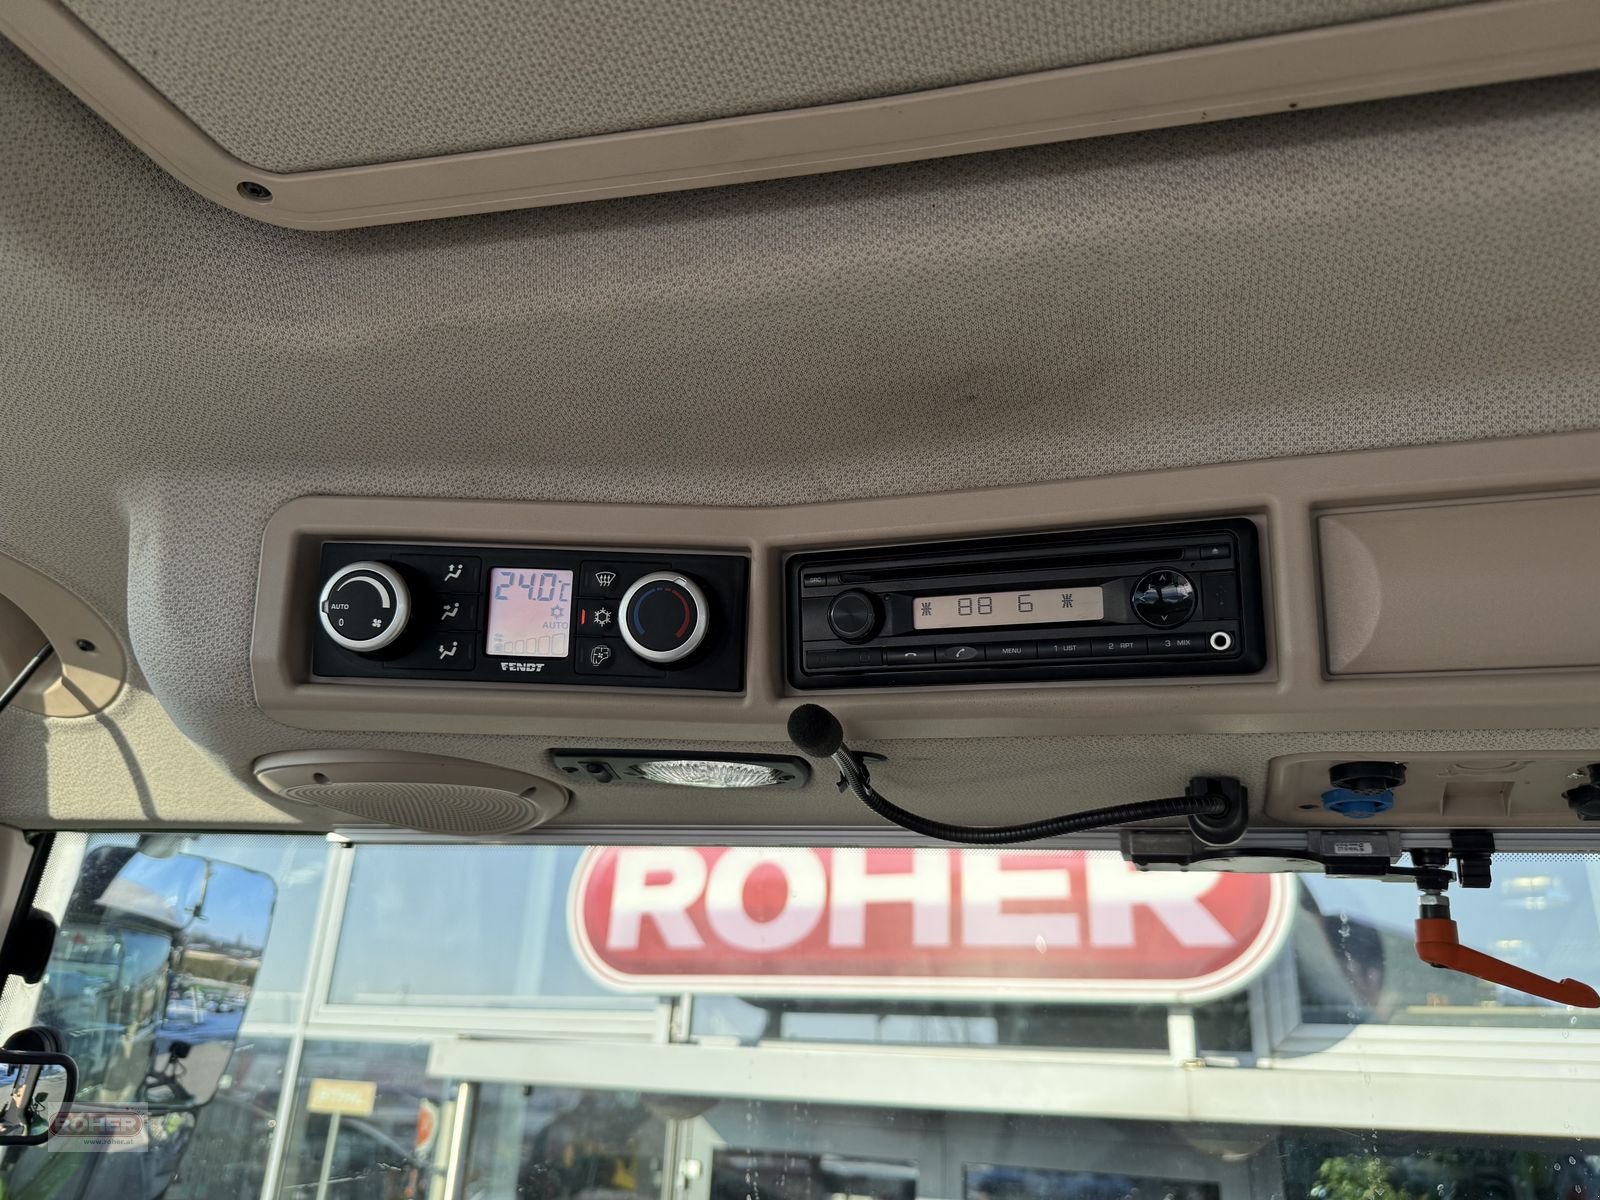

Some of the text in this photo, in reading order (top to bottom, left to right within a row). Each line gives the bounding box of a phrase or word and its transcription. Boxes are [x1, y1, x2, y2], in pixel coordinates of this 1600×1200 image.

[331, 602, 350, 611] AUTO
[1018, 594, 1034, 613] 6
[542, 621, 569, 630] AUTO
[1108, 641, 1134, 650] 2 RPT
[1164, 638, 1191, 647] 3 MIX
[1002, 647, 1022, 655] MENU
[1053, 645, 1058, 653] 1
[500, 662, 545, 672] FENDT
[605, 846, 1236, 951] ROHER
